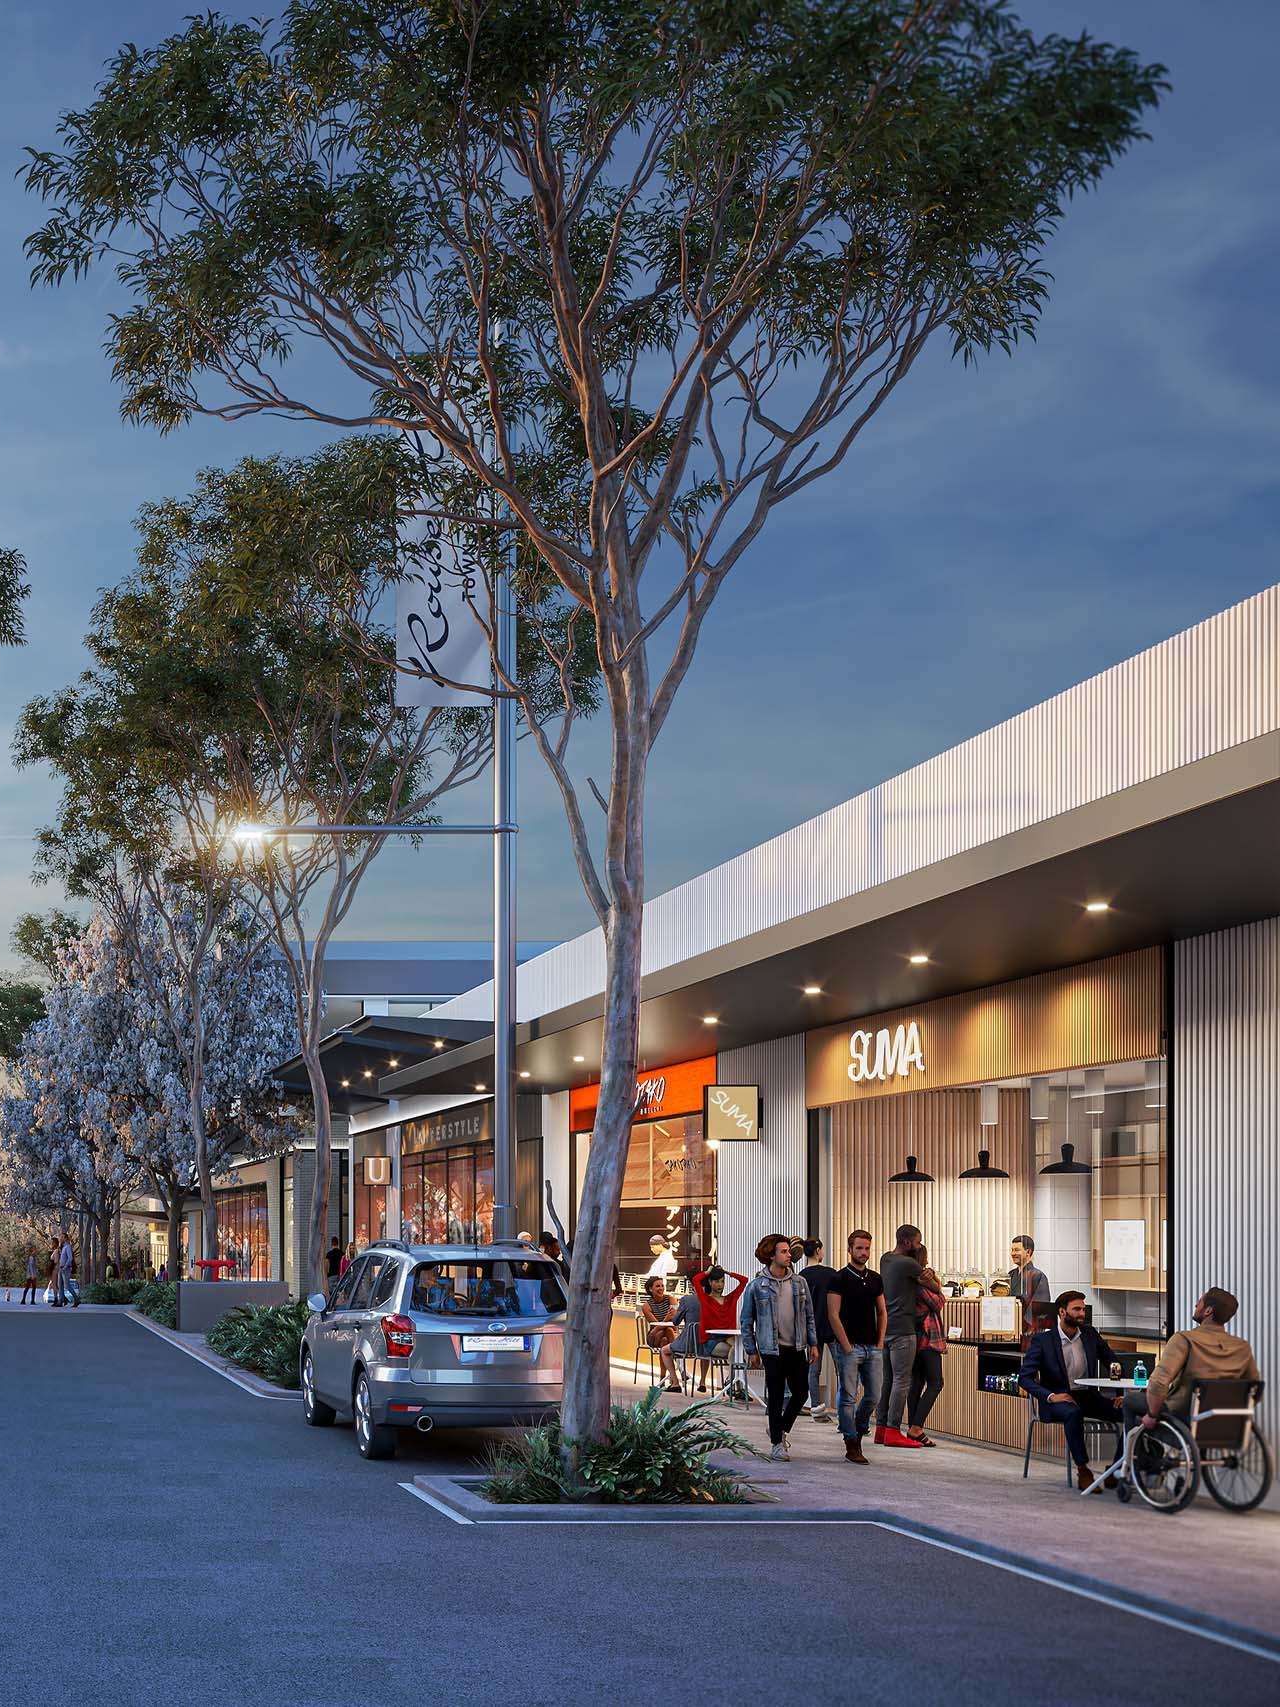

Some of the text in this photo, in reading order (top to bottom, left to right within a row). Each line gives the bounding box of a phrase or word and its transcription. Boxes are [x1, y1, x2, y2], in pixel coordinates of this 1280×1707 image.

[847, 1021, 925, 1081] SUMA
[710, 1090, 754, 1136] SUMA
[367, 1157, 386, 1183] U
